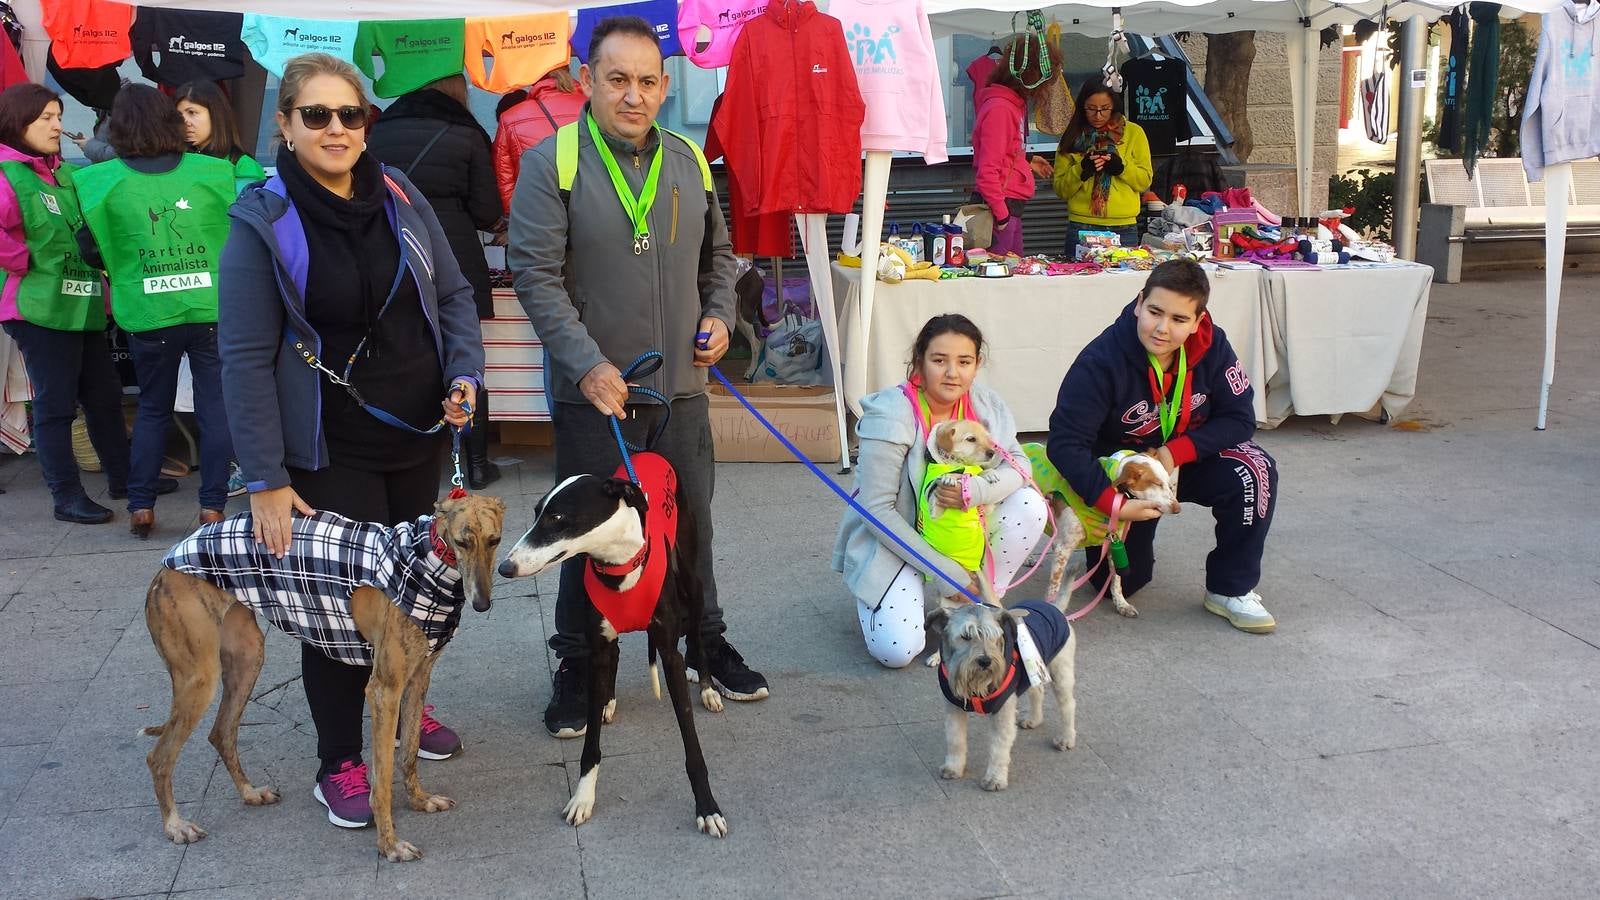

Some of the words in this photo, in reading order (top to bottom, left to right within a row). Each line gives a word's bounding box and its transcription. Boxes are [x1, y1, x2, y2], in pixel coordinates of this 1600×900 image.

[731, 9, 756, 21] galgos
[655, 23, 669, 32] 112
[299, 34, 328, 43] galgos
[329, 35, 342, 43] 112
[515, 34, 543, 44] galgos
[543, 32, 556, 40] 112
[183, 41, 212, 51] galgos
[213, 43, 226, 52] 112
[139, 242, 207, 261] Partido
[142, 258, 209, 275] Animalista
[150, 277, 203, 291] PACMA
[1242, 505, 1254, 526] DEPT
